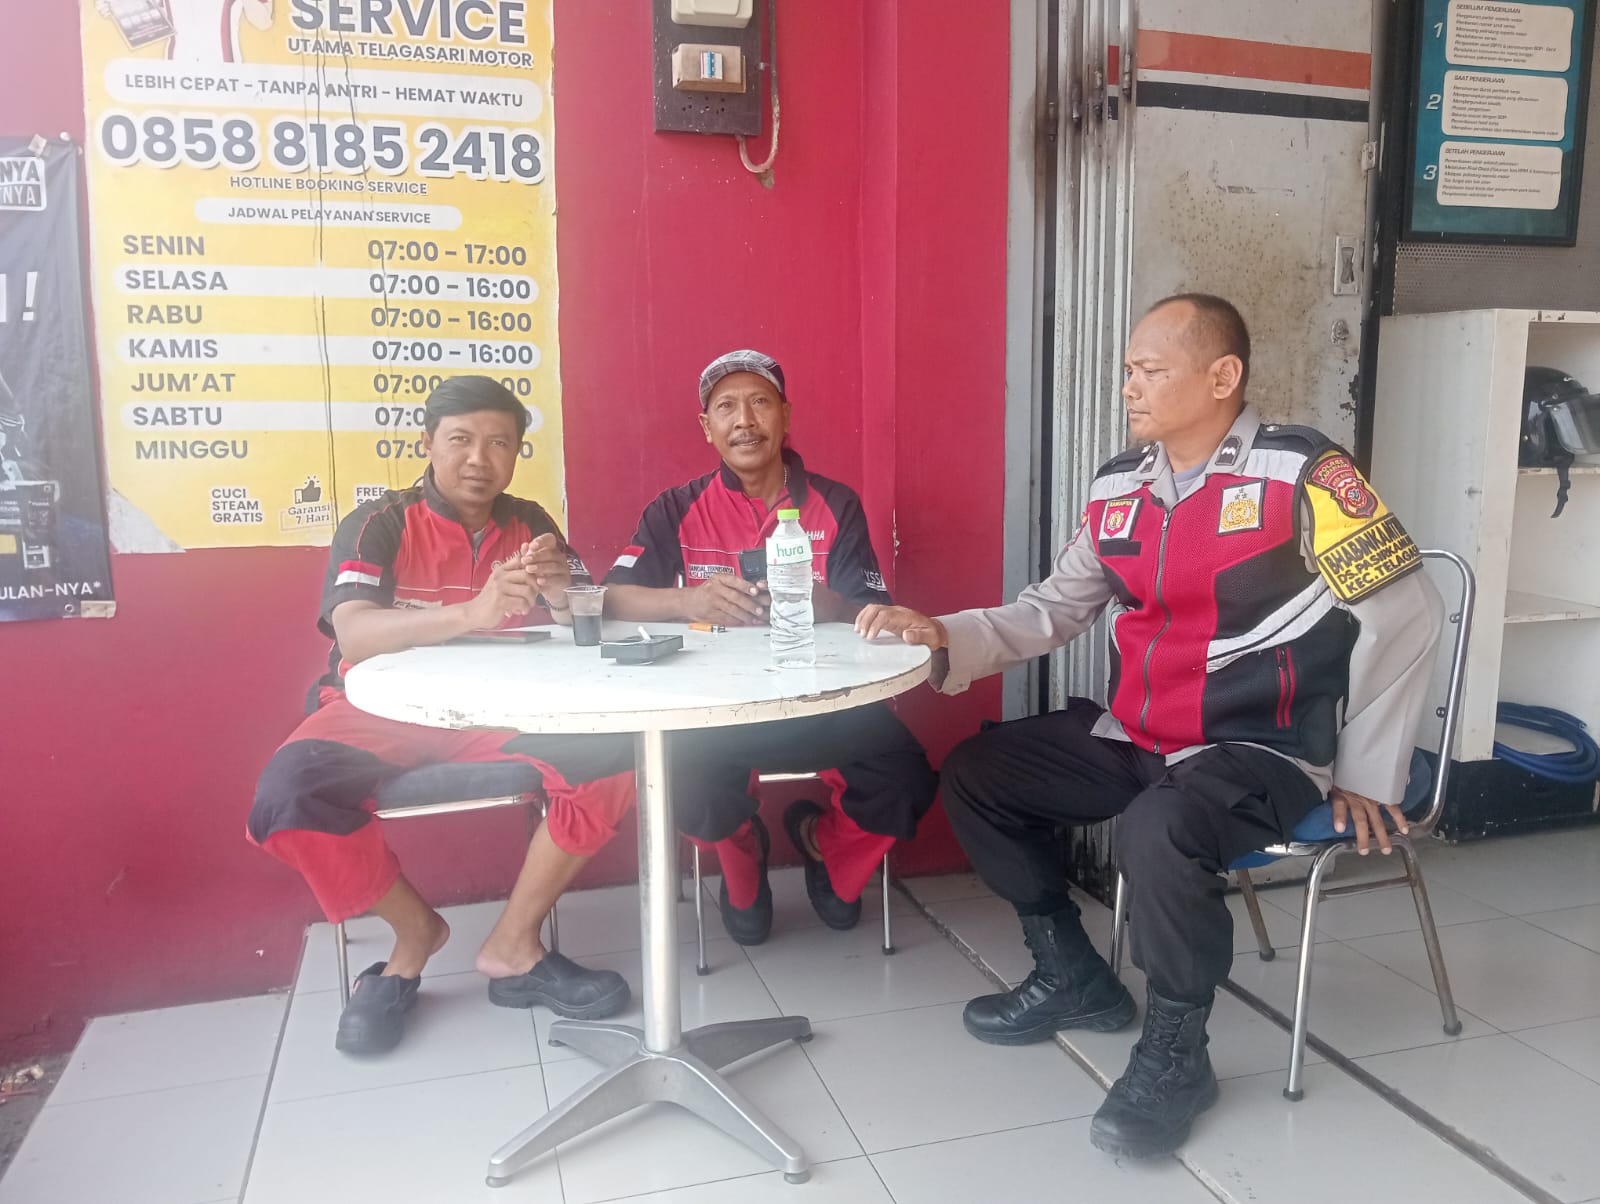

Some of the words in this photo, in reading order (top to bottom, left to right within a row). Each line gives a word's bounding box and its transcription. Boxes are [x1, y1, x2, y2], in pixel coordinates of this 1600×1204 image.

[291, 0, 526, 44] SERVICE
[1433, 22, 1443, 38] 1
[288, 40, 352, 56] UTAMA
[357, 42, 465, 63] TELAGASARI
[469, 48, 533, 67] MOTOR
[125, 74, 175, 90] LEBIH
[180, 76, 239, 93] CEPAT
[258, 79, 319, 96] TANPA
[325, 83, 377, 99] ANTRI
[395, 86, 455, 104] HEMAT
[459, 89, 523, 107] WAKTU
[1425, 94, 1441, 110] 2
[101, 114, 256, 165] 0858
[273, 120, 405, 169] 8185
[419, 129, 542, 178] 2418
[1423, 165, 1438, 181] 3
[230, 176, 292, 191] HOTLINE
[296, 178, 364, 193] BOOKING
[368, 180, 427, 195] SERVICE
[228, 206, 288, 220] JADWAL
[291, 208, 373, 222] PELAYANAN
[375, 210, 431, 224] SERVICE
[123, 235, 205, 256] SENIN
[368, 239, 439, 262] 07:00
[465, 244, 527, 266] 17:00
[125, 269, 228, 291] SELASA
[369, 273, 440, 296] 07:00
[466, 278, 531, 300] 16:00
[127, 304, 203, 325] RABU
[371, 306, 442, 329] 07:00
[468, 310, 533, 333] 16:00
[129, 338, 219, 360] KAMIS
[372, 340, 443, 362] 07:00
[469, 344, 534, 366] 16:00
[131, 372, 236, 393] JUM'AT
[132, 406, 223, 427] SABTU
[375, 407, 426, 427] 07:0
[135, 438, 248, 460] MINGGU
[376, 439, 427, 460] 07:0
[211, 488, 246, 499] CUCI
[356, 487, 385, 497] FREE
[212, 500, 259, 511] STEAM
[288, 503, 330, 516] Garansi
[213, 512, 263, 523] GRATIS
[296, 515, 301, 524] 7
[305, 514, 329, 524] Hari
[776, 543, 804, 558] hura
